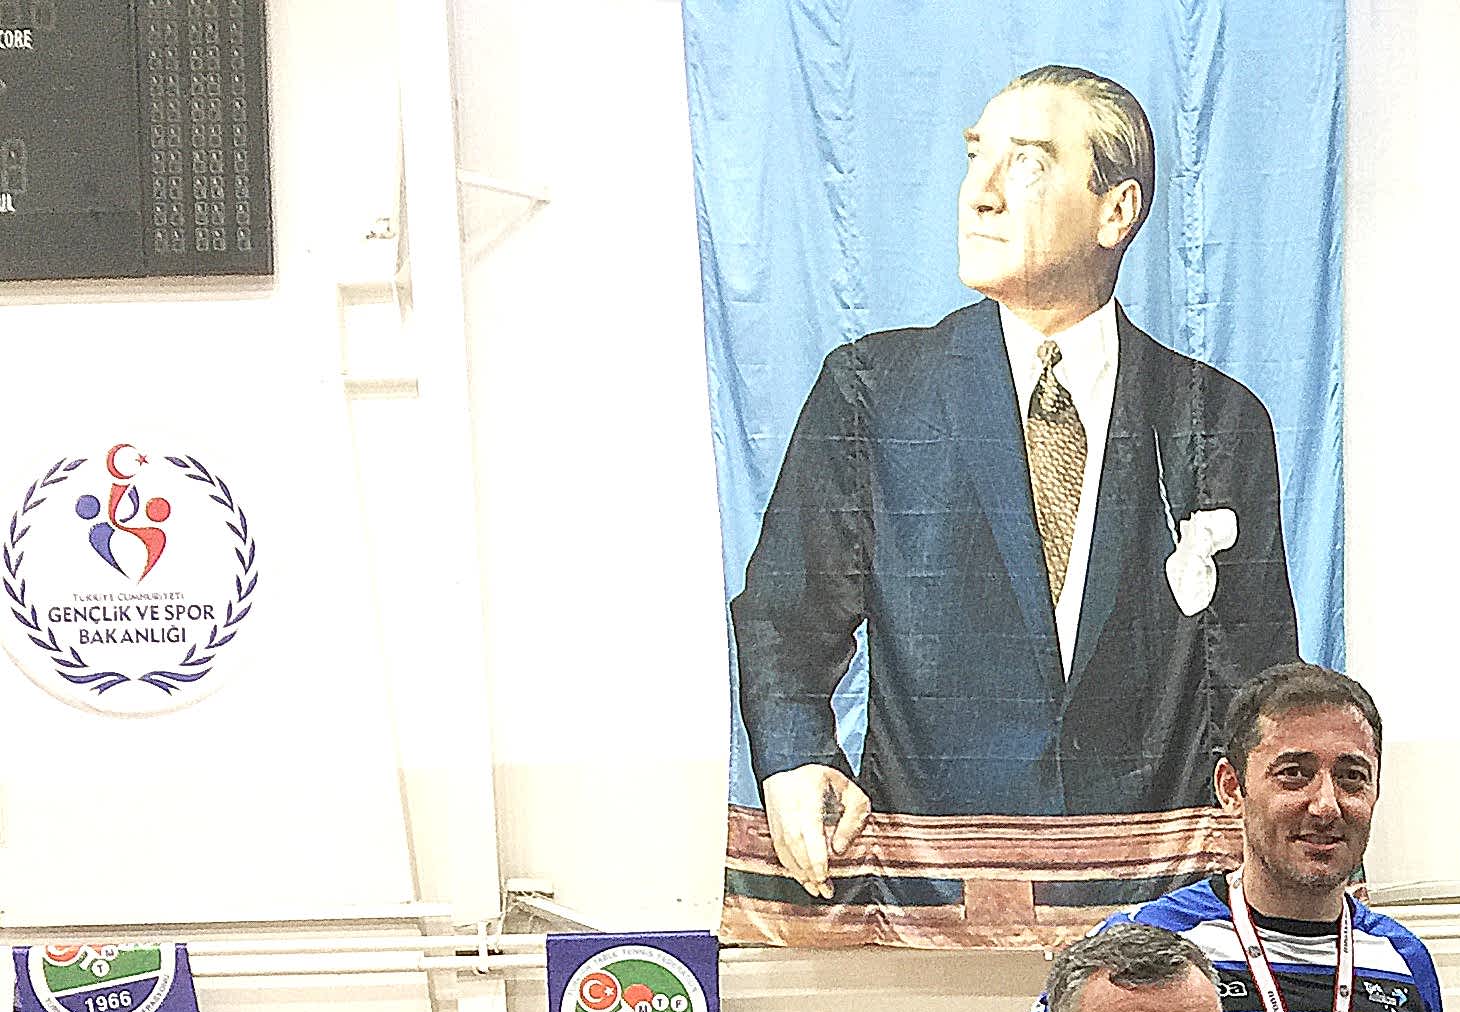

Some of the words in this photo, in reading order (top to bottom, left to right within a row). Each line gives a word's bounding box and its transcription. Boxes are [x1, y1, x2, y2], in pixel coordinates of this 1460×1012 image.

[136, 605, 160, 621] VE
[164, 604, 215, 621] SPOR
[79, 625, 186, 645] BAKANLIĞI
